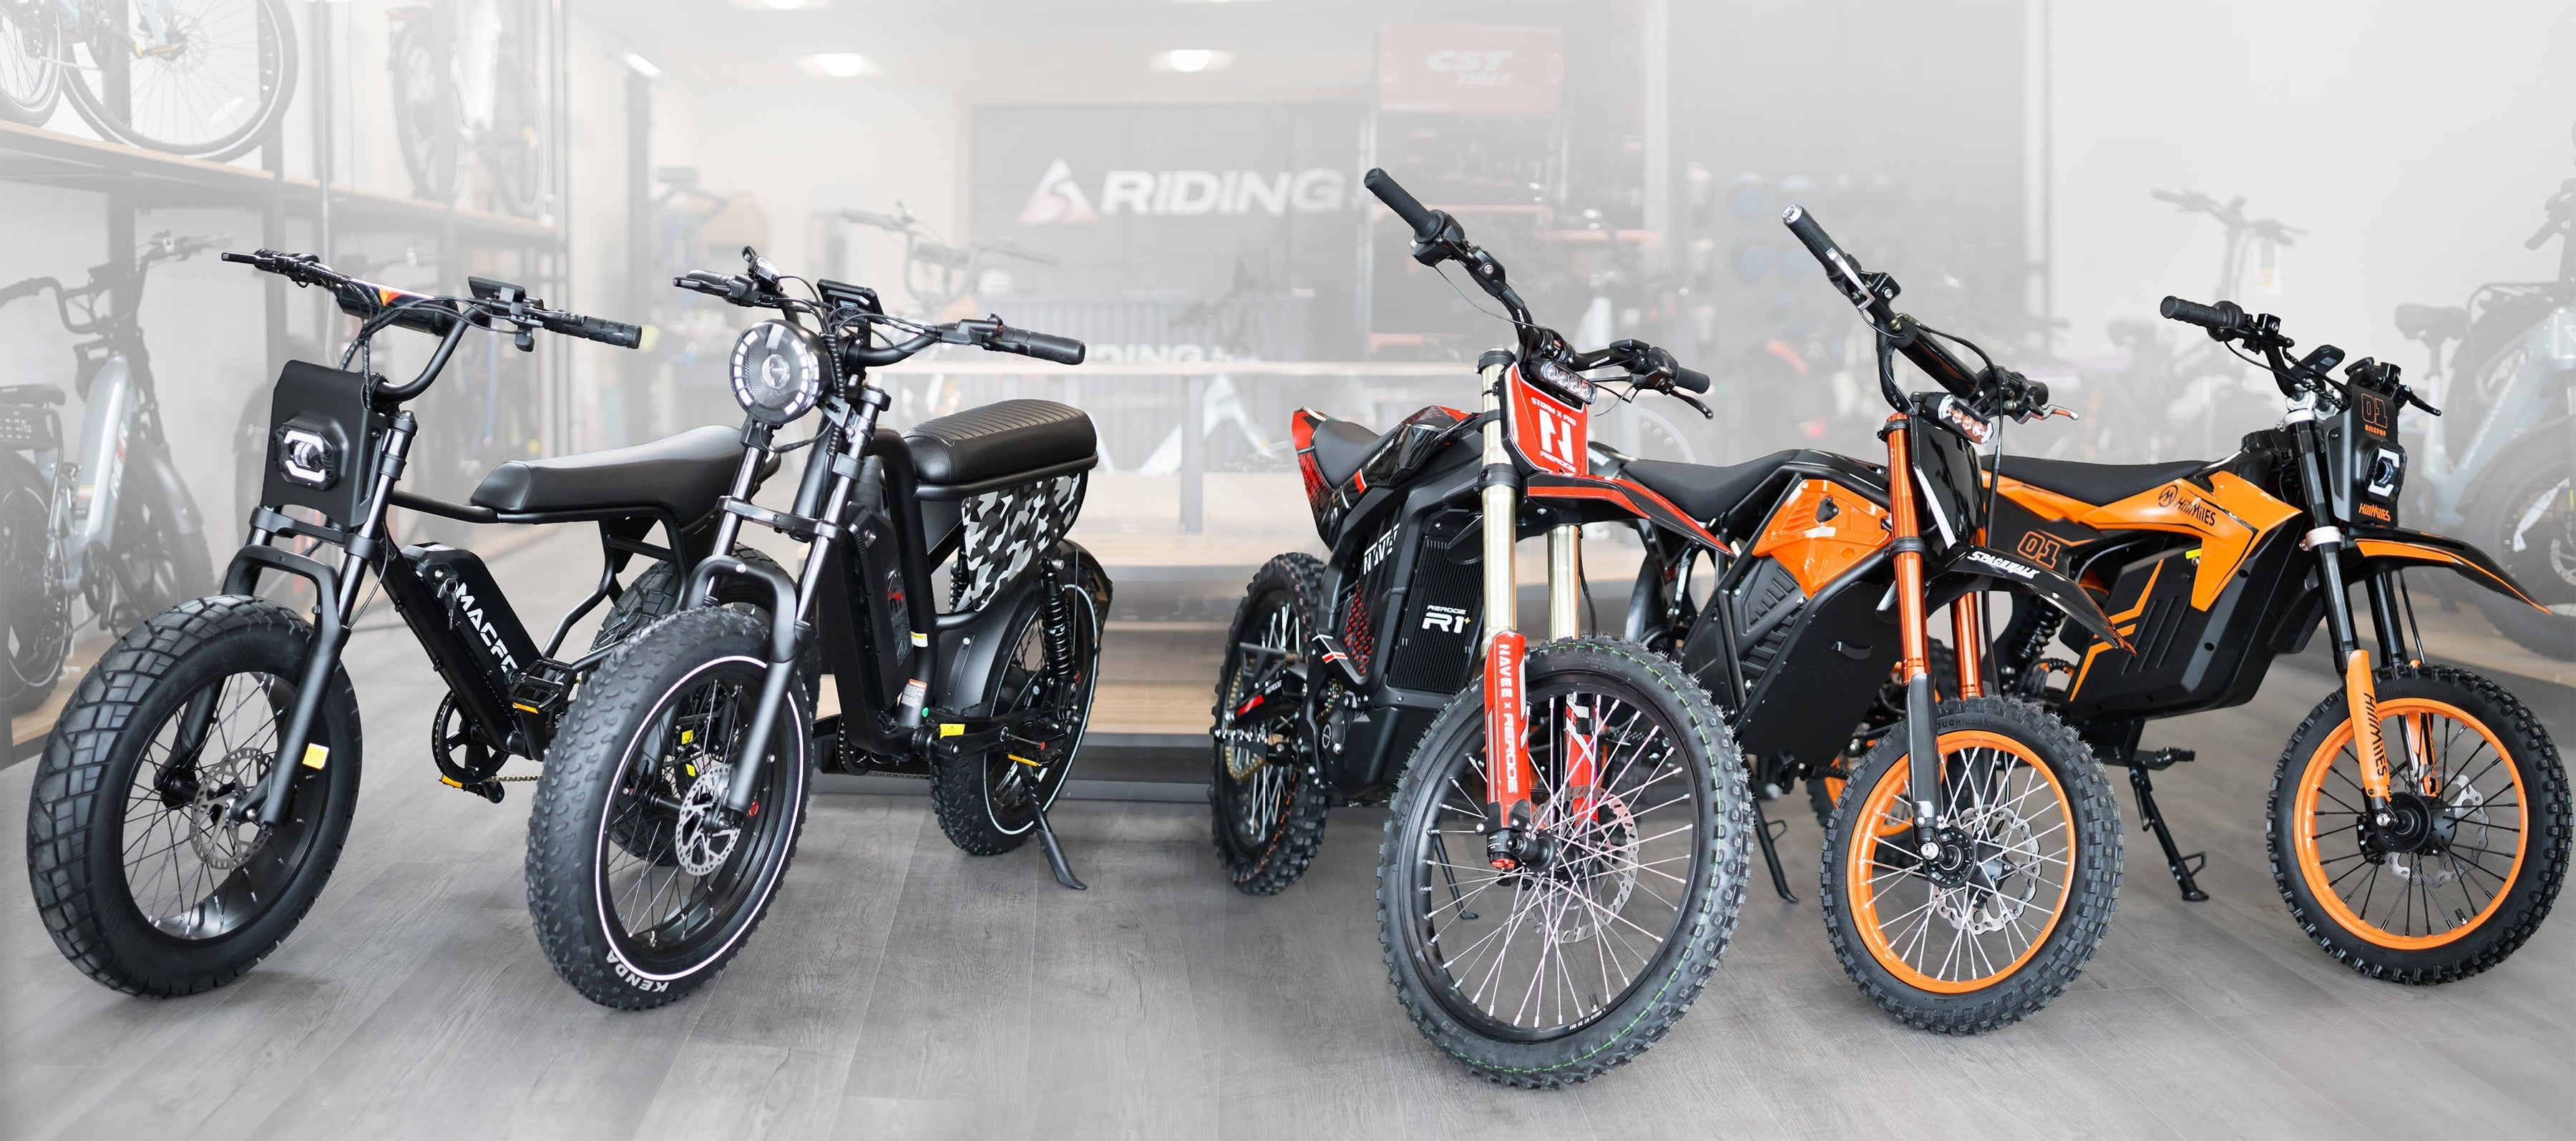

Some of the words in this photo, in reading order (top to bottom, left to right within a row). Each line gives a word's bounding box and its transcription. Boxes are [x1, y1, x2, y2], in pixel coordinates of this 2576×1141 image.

[1426, 50, 1514, 72] CST
[1098, 167, 1347, 215] RIDING
[1531, 397, 1556, 415] STORM
[1556, 410, 1563, 418] X
[1563, 414, 1577, 426] PRO
[2361, 393, 2388, 429] 01
[1967, 551, 2041, 579] SPACEWALK
[2017, 531, 2061, 569] 01
[1498, 644, 1513, 698] NAVEE
[606, 949, 670, 992] KENDA
